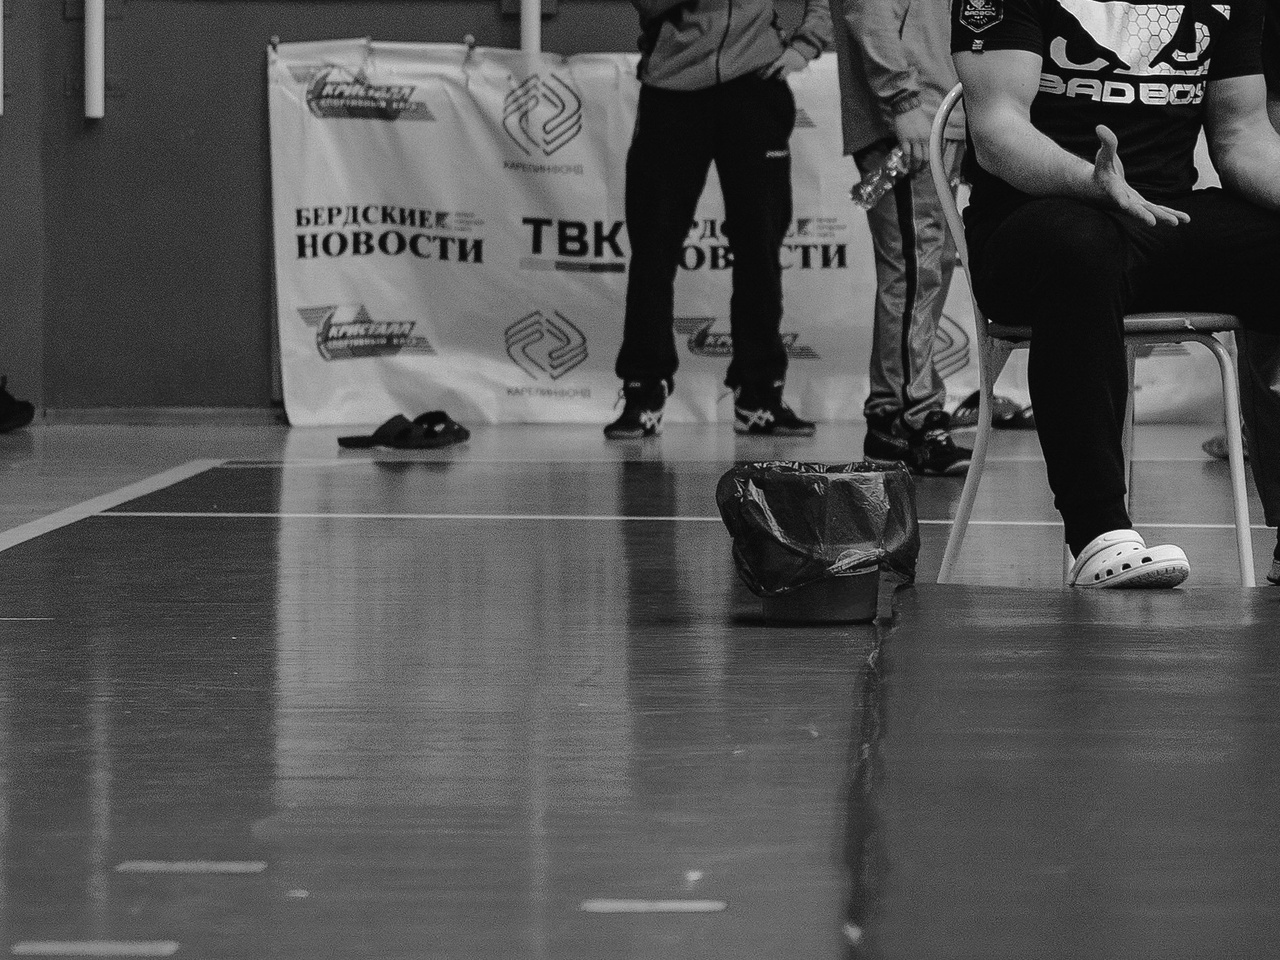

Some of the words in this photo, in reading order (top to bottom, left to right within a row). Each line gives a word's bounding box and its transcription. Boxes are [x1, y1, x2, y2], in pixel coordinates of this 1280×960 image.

[1040, 72, 1135, 104] BAD
[296, 204, 433, 229] БЕРДСКИЕ
[296, 230, 484, 264] НОВОСТИ
[522, 217, 624, 258] ТВК
